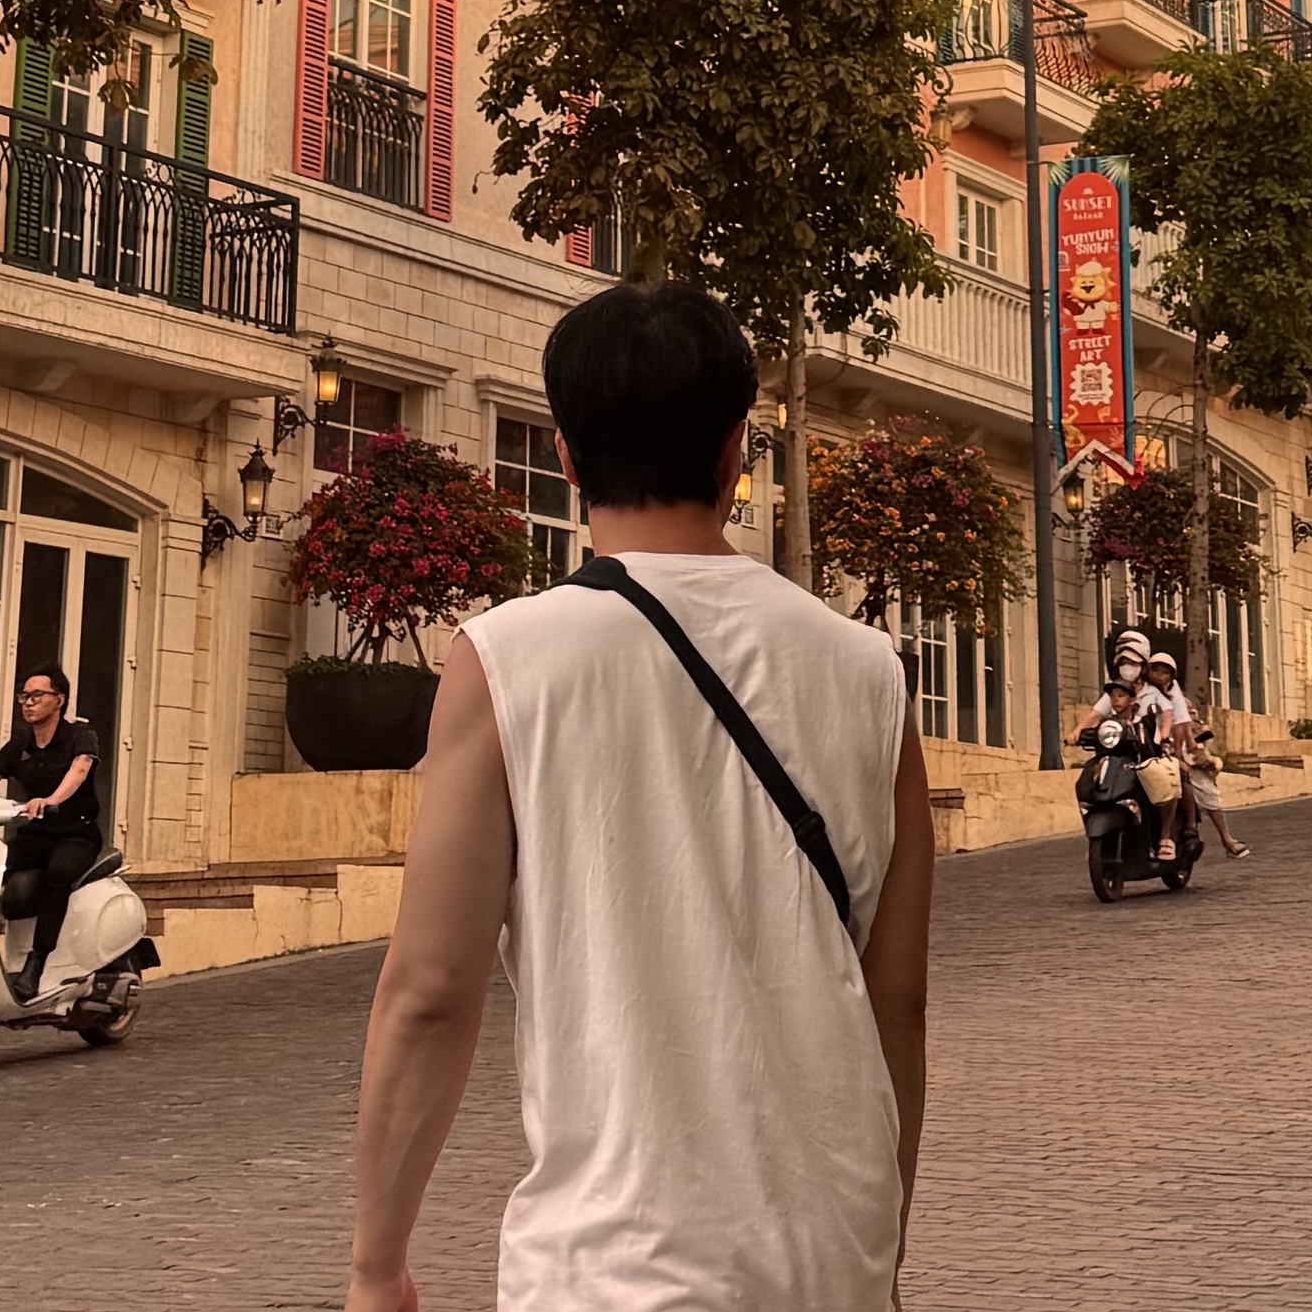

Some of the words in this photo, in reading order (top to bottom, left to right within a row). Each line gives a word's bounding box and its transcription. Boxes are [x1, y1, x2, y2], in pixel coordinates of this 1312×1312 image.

[1063, 195, 1113, 211] SUNSET
[1069, 335, 1112, 350] STREET
[1080, 349, 1103, 362] ART
